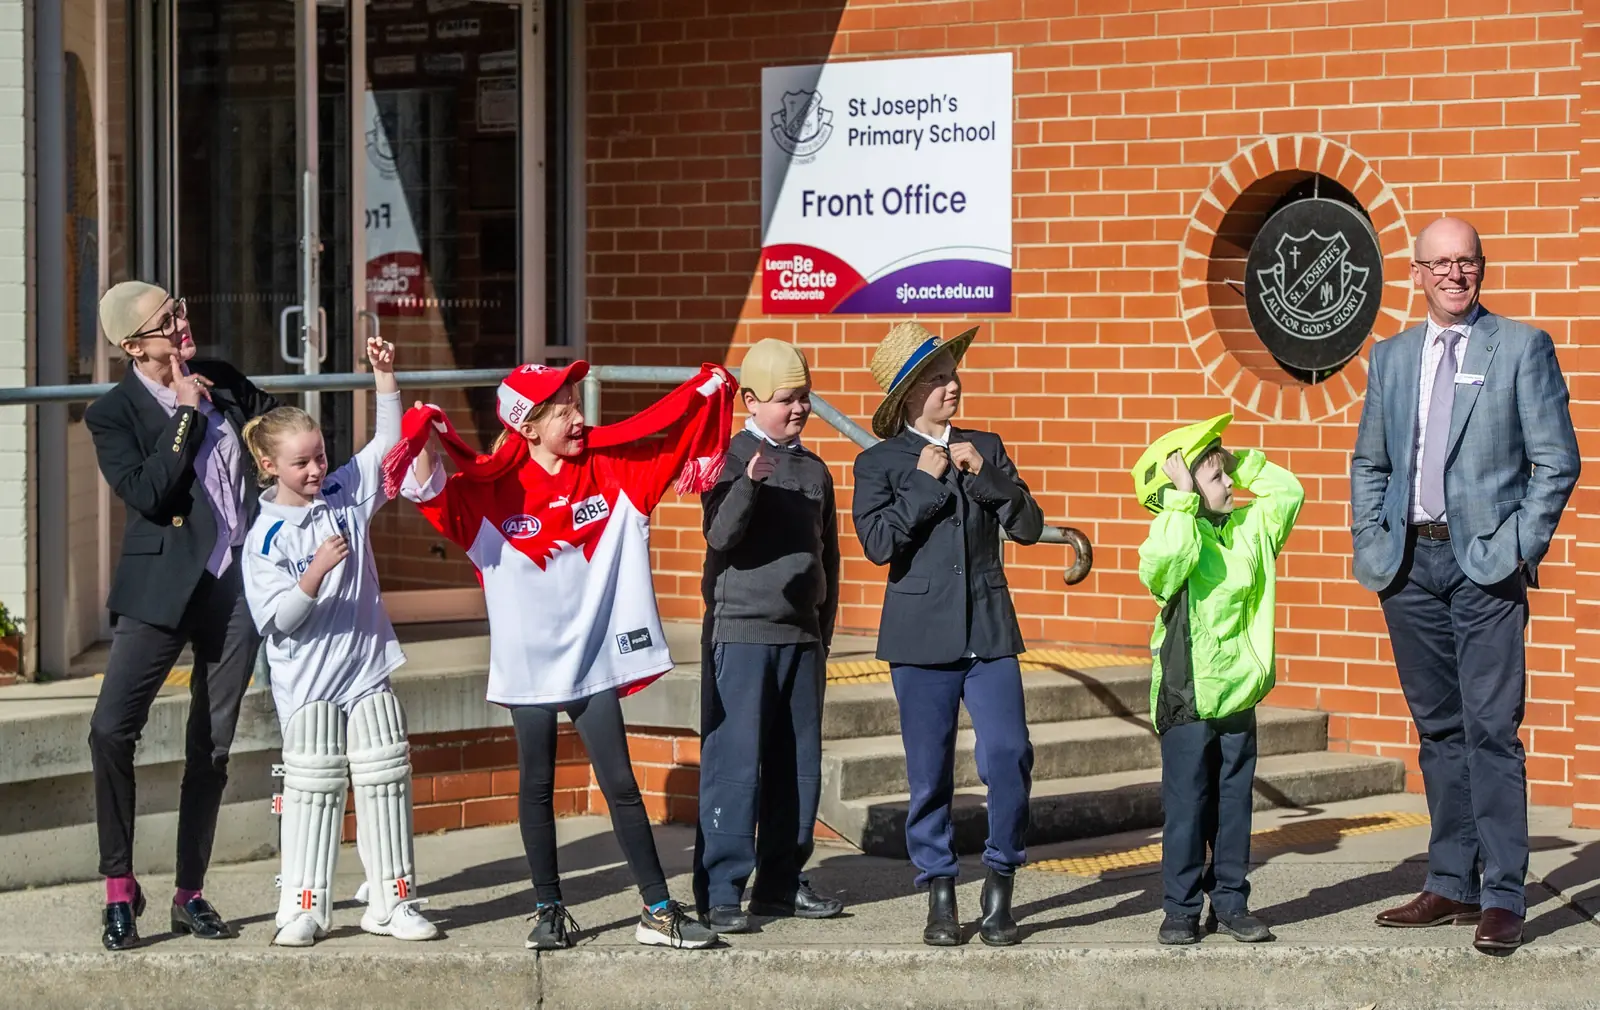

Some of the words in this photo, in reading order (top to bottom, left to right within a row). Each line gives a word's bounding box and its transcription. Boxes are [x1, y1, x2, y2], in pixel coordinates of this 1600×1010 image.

[849, 98, 867, 117] St
[872, 94, 958, 120] Joseph's
[849, 126, 924, 151] Primary
[930, 121, 996, 144] School
[802, 189, 874, 217] Front
[882, 184, 967, 215] Office
[793, 255, 814, 273] Be
[1303, 244, 1340, 290] JOSEPH'S
[779, 269, 837, 288] Create
[770, 288, 825, 301] Collaborate
[896, 282, 994, 304] sjo.act.edu.au
[1267, 297, 1281, 316] ALL
[1280, 315, 1300, 331] FOR
[1301, 321, 1332, 335] GOD'S
[1333, 295, 1359, 326] GLORY
[508, 399, 528, 425] QBE
[574, 500, 608, 524] QBE
[506, 520, 538, 533] AFL
